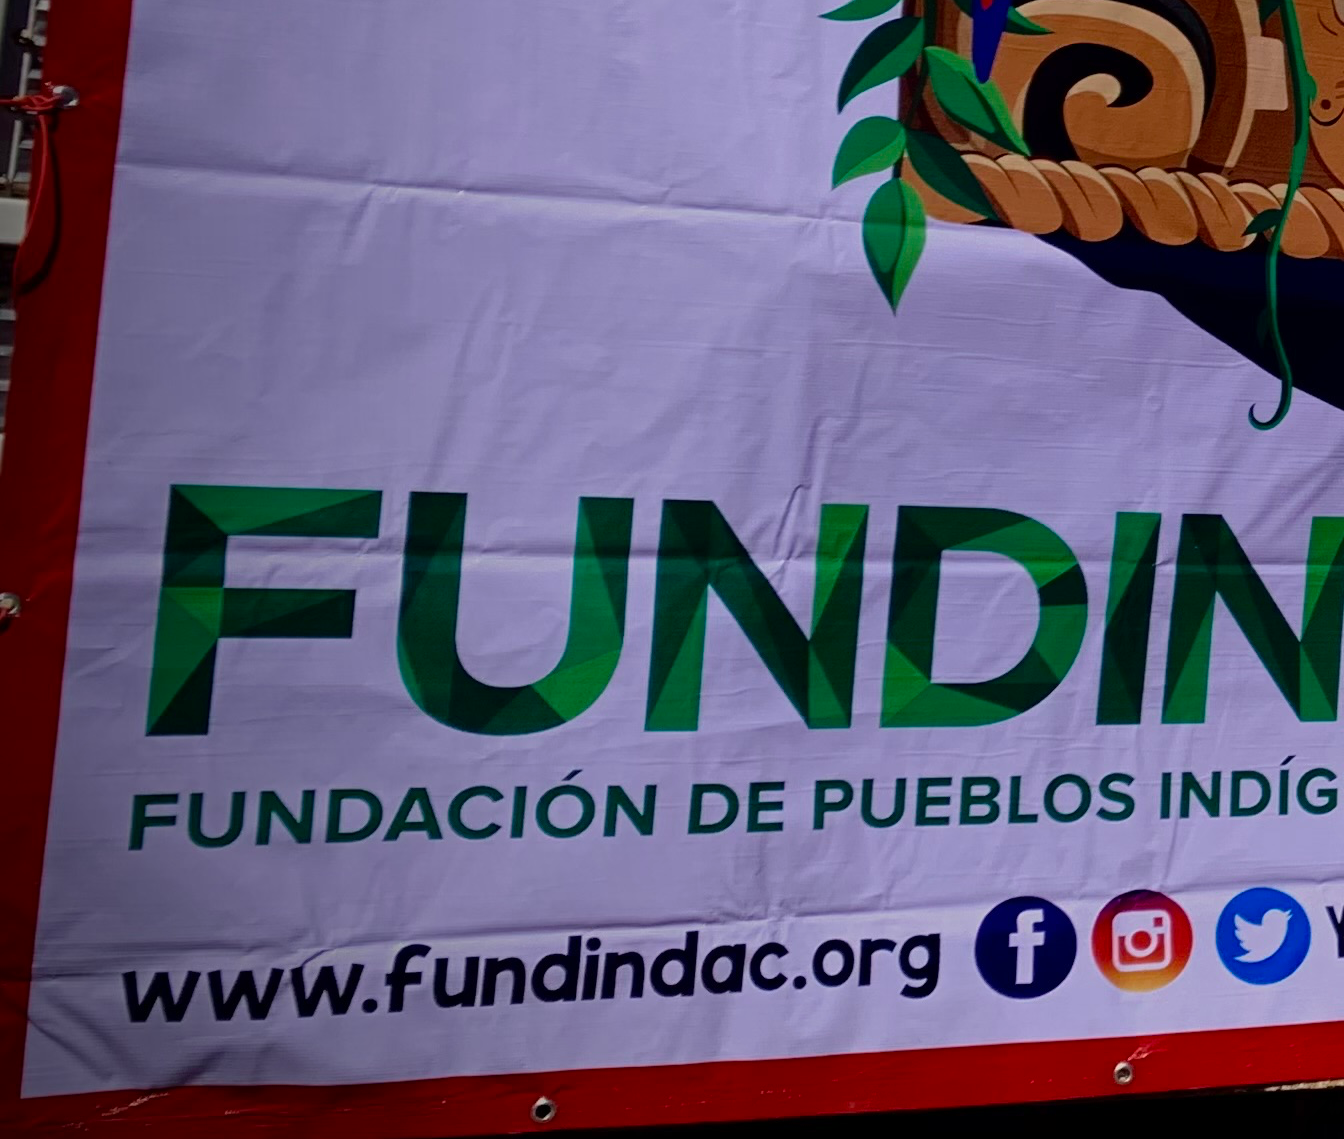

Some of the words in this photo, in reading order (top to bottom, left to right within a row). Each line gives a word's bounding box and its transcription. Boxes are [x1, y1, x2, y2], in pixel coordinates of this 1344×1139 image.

[128, 769, 658, 850] FUNDACIÓN
[687, 780, 786, 835] DE
[812, 772, 1136, 830] PUEBLOS
[122, 930, 942, 1023] www.fundindac.org
